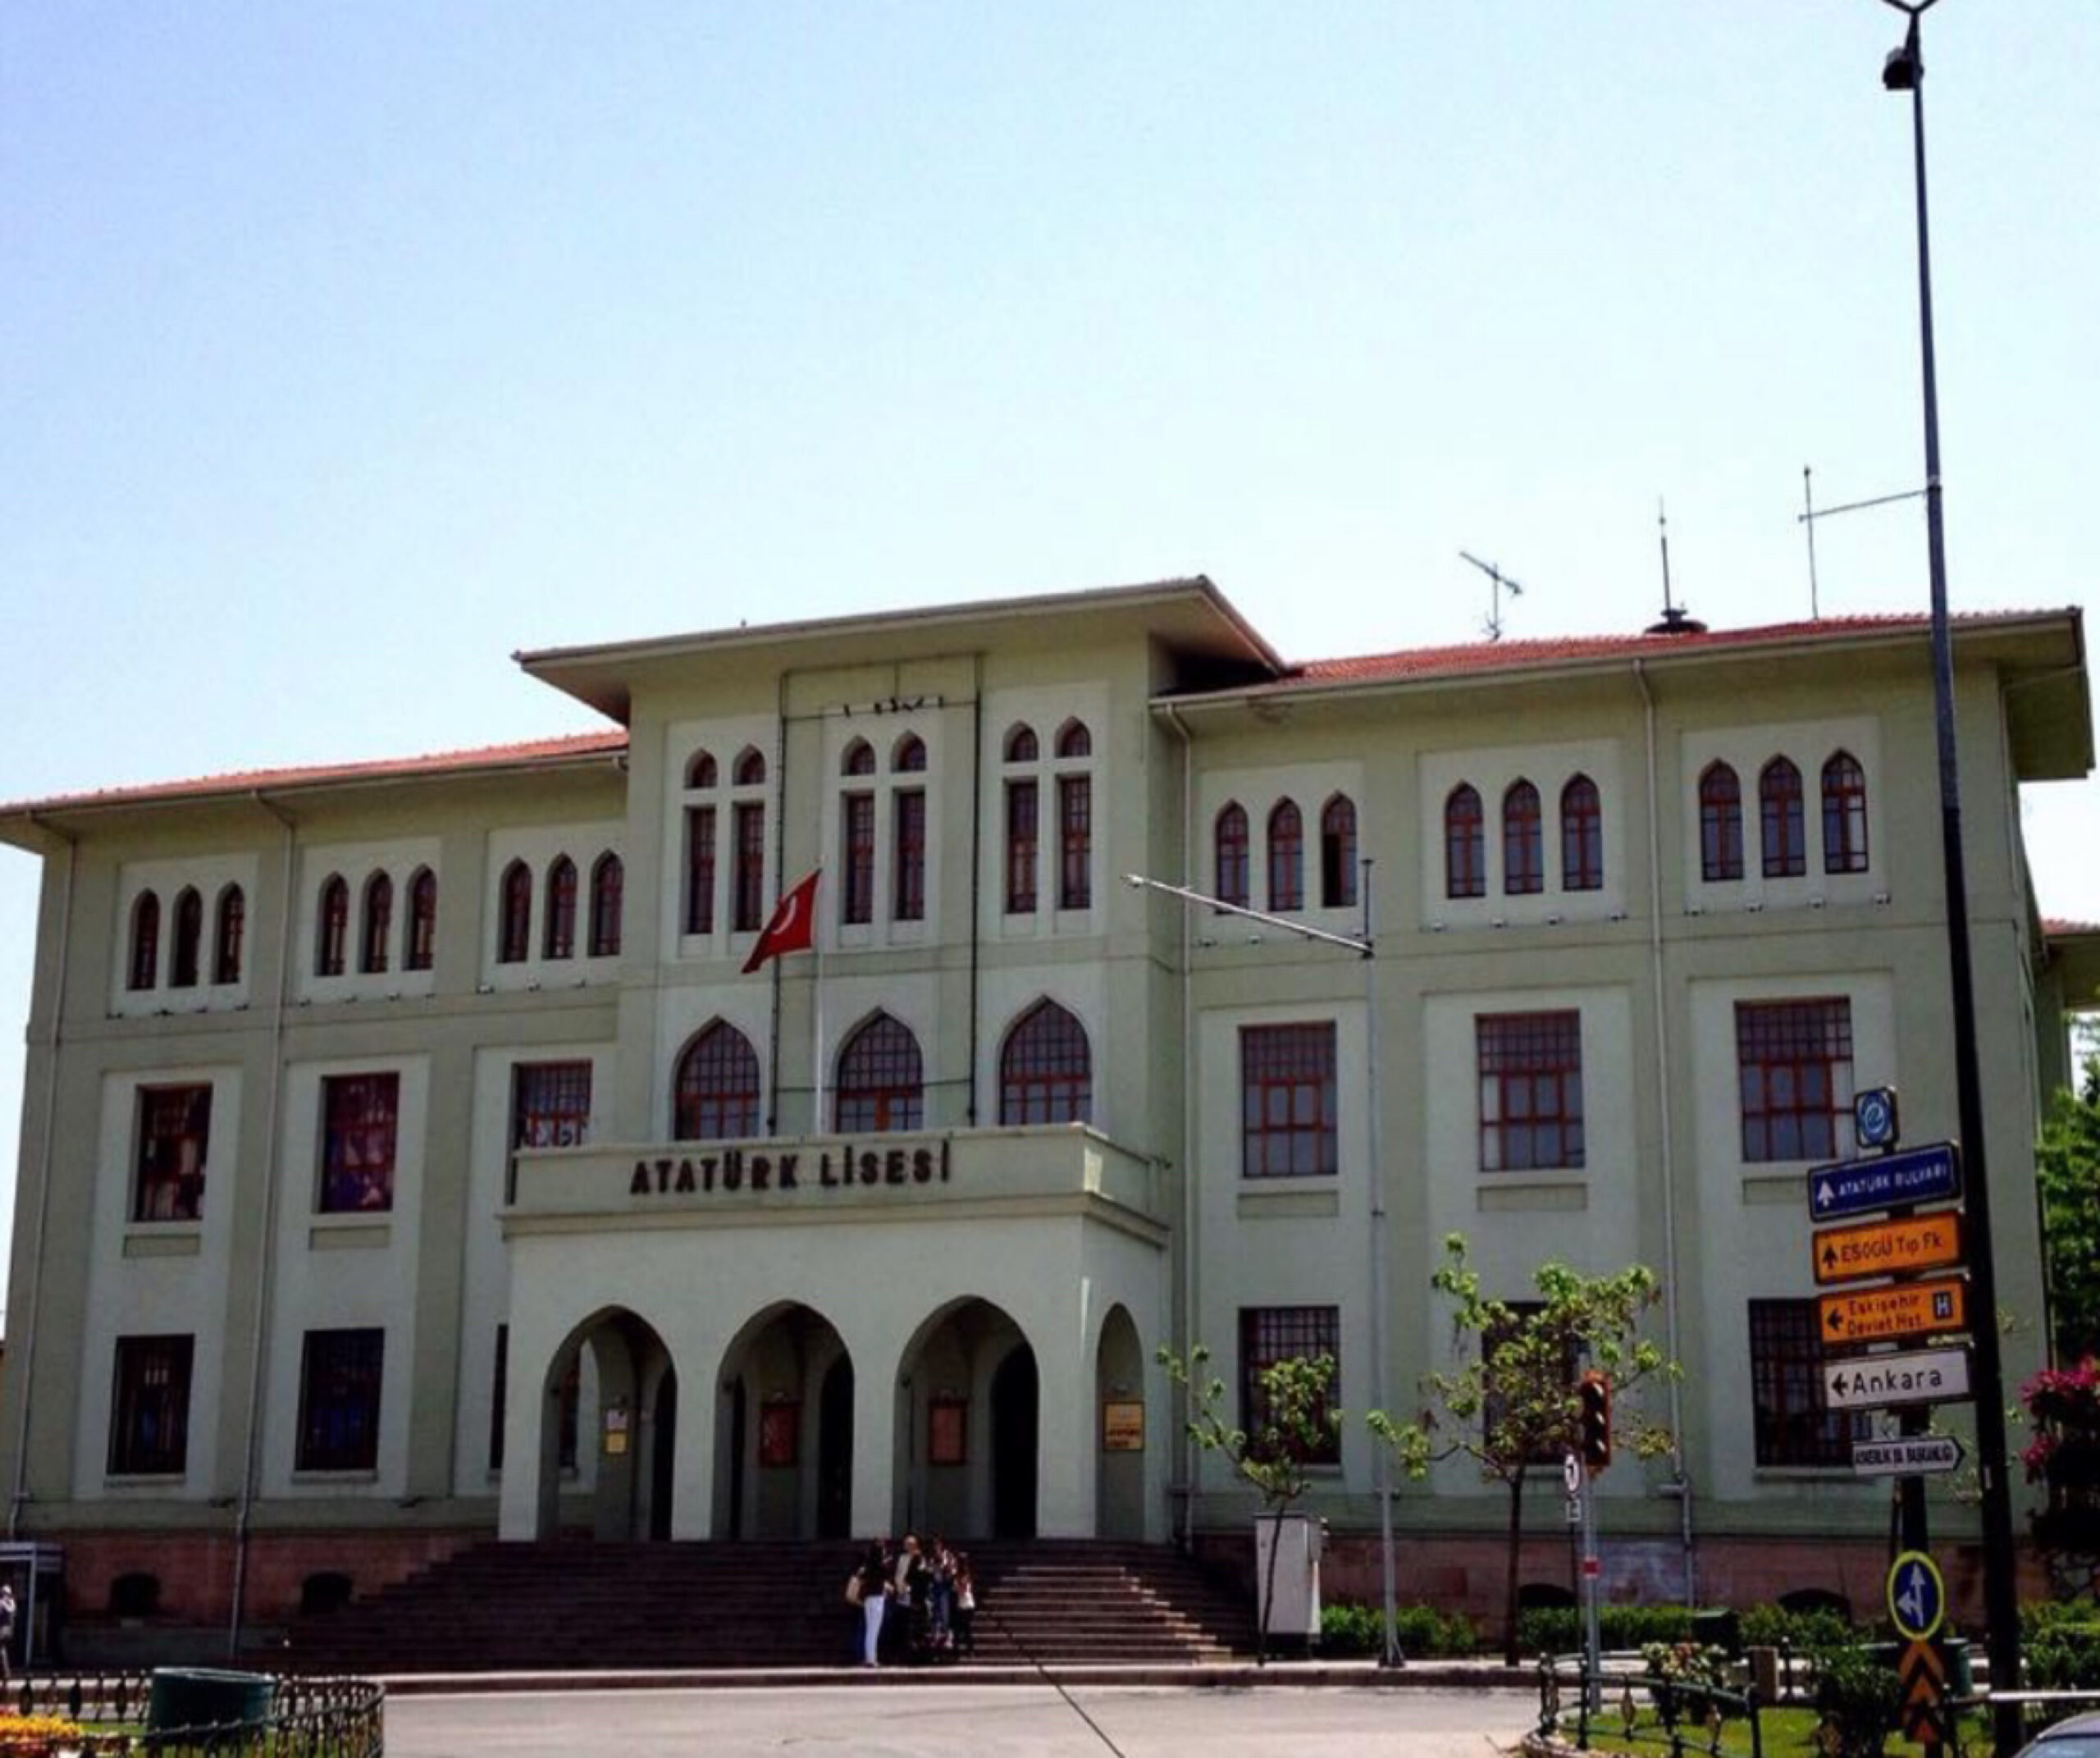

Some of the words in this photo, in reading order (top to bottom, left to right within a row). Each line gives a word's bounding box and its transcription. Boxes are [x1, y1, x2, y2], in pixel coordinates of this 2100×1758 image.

[630, 1150, 800, 1194] ATATÜRK
[821, 1139, 950, 1186] LİSESİ
[1852, 1368, 1943, 1395] Ankara
